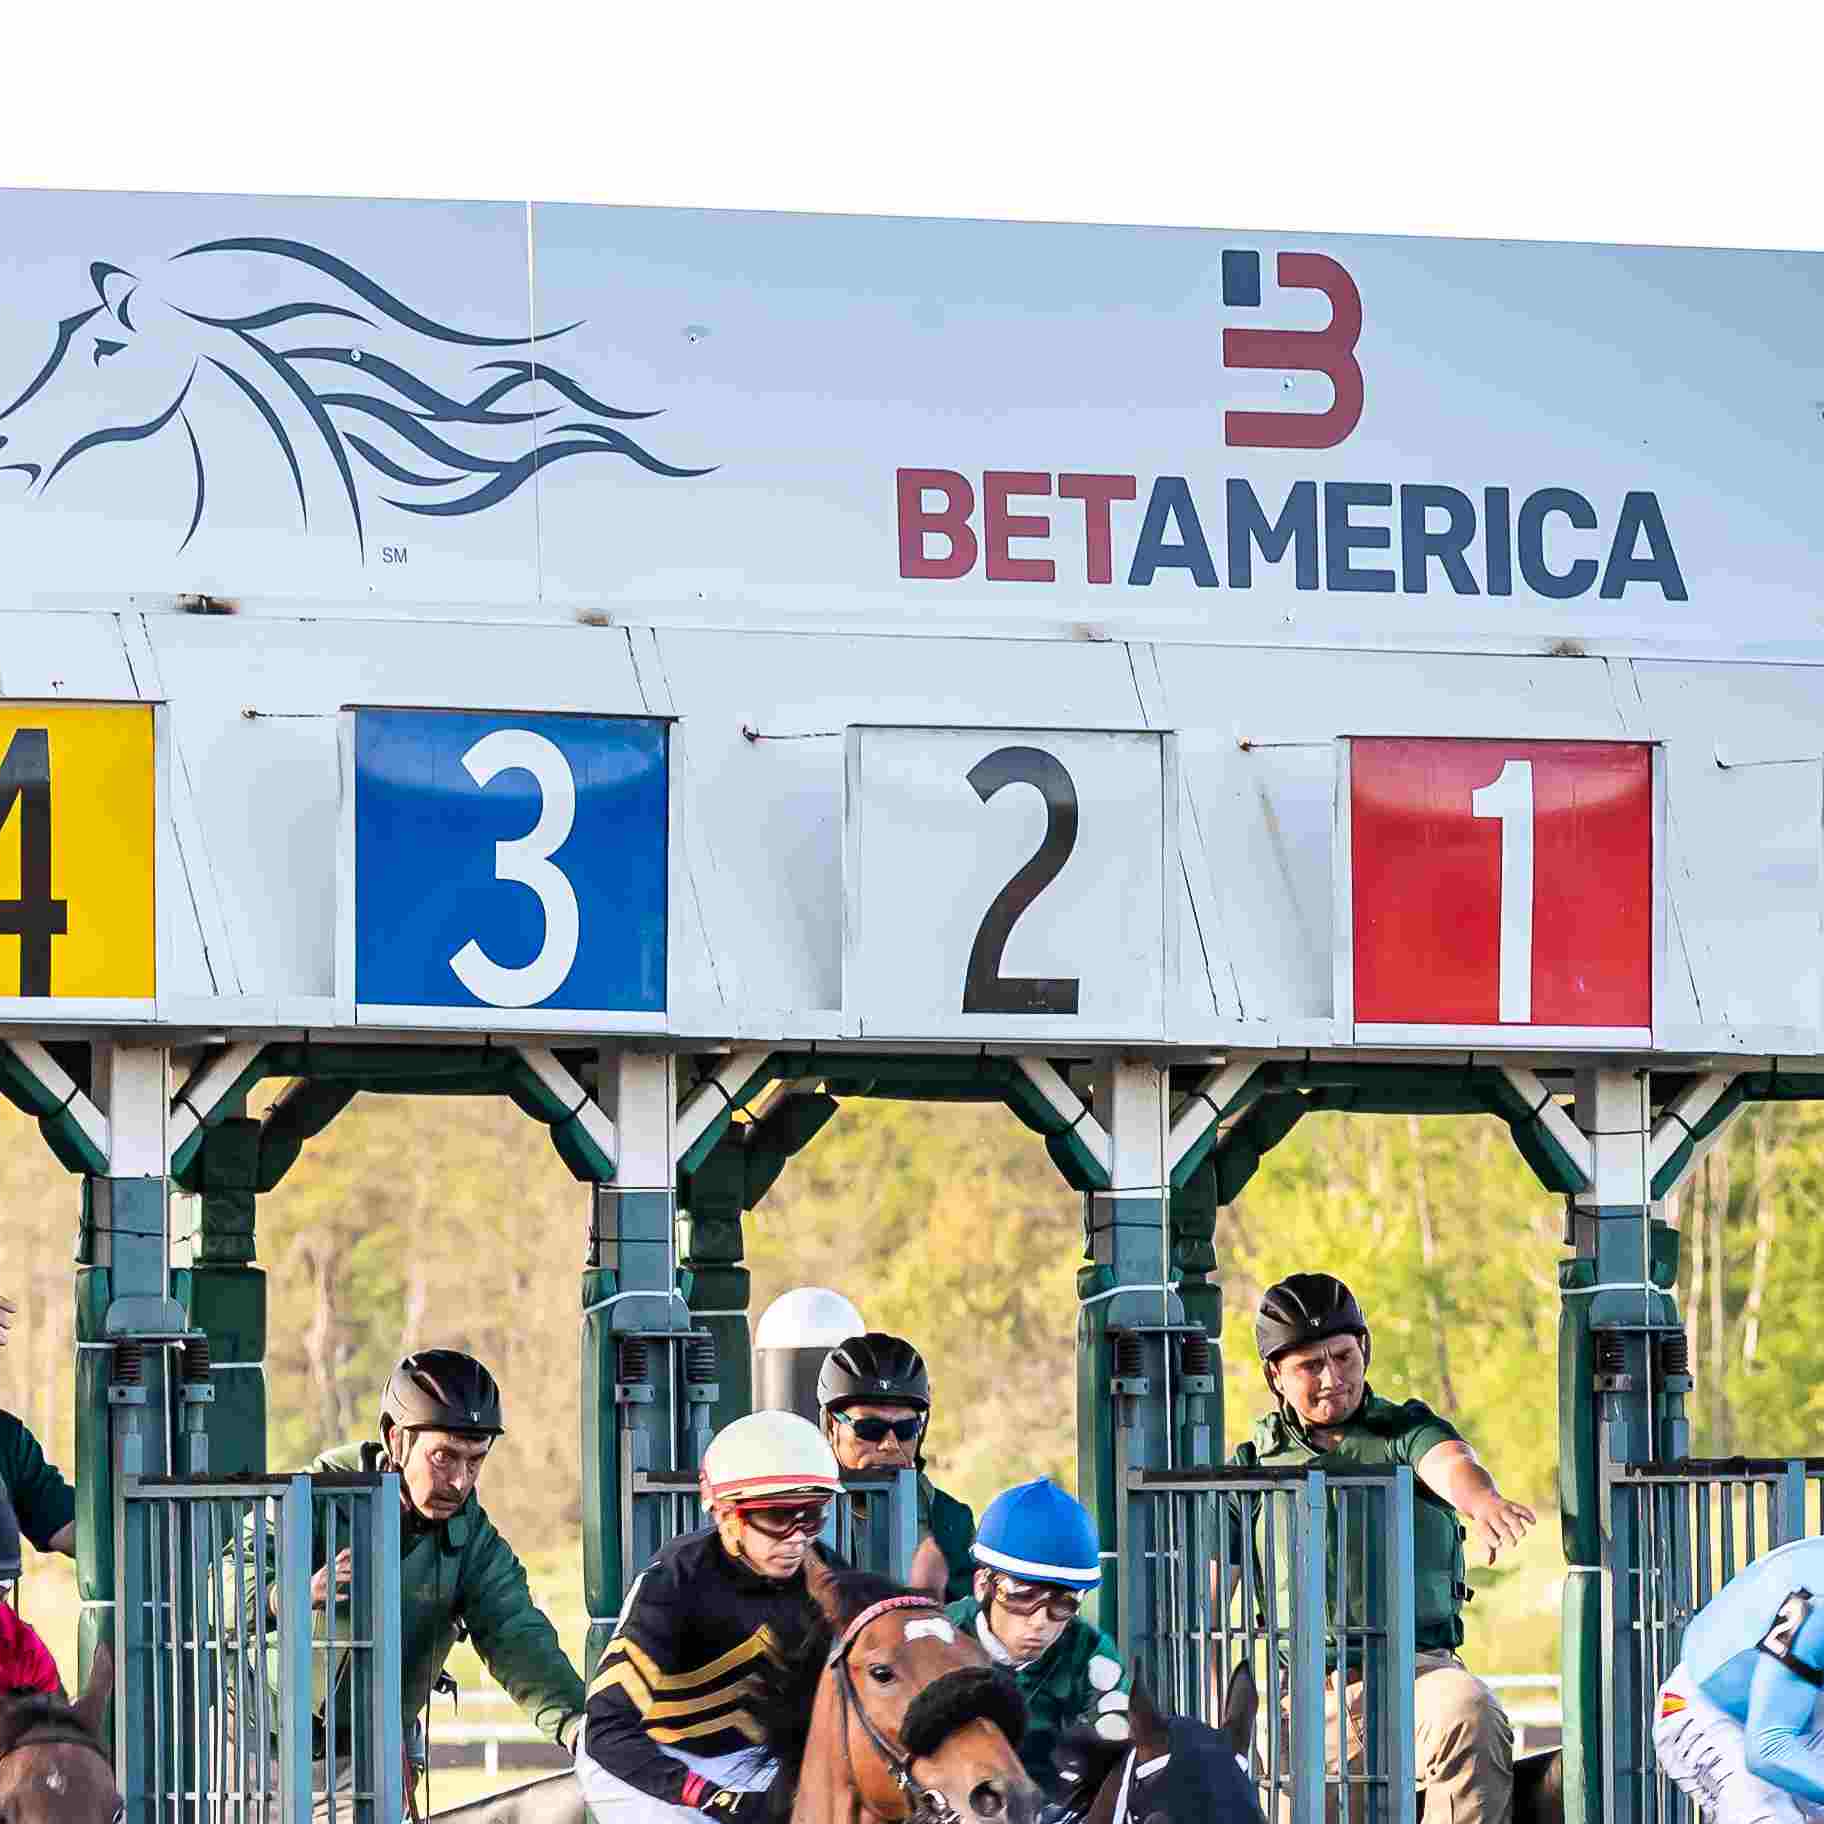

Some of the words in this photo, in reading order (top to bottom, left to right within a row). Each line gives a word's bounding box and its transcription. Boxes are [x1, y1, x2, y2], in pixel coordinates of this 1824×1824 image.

[382, 546, 408, 564] SM
[895, 467, 1689, 602] BETAMERICA
[448, 729, 580, 1009] 3
[960, 745, 1081, 1016] 2
[1471, 759, 1535, 1022] 1
[1763, 1598, 1802, 1657] 2
